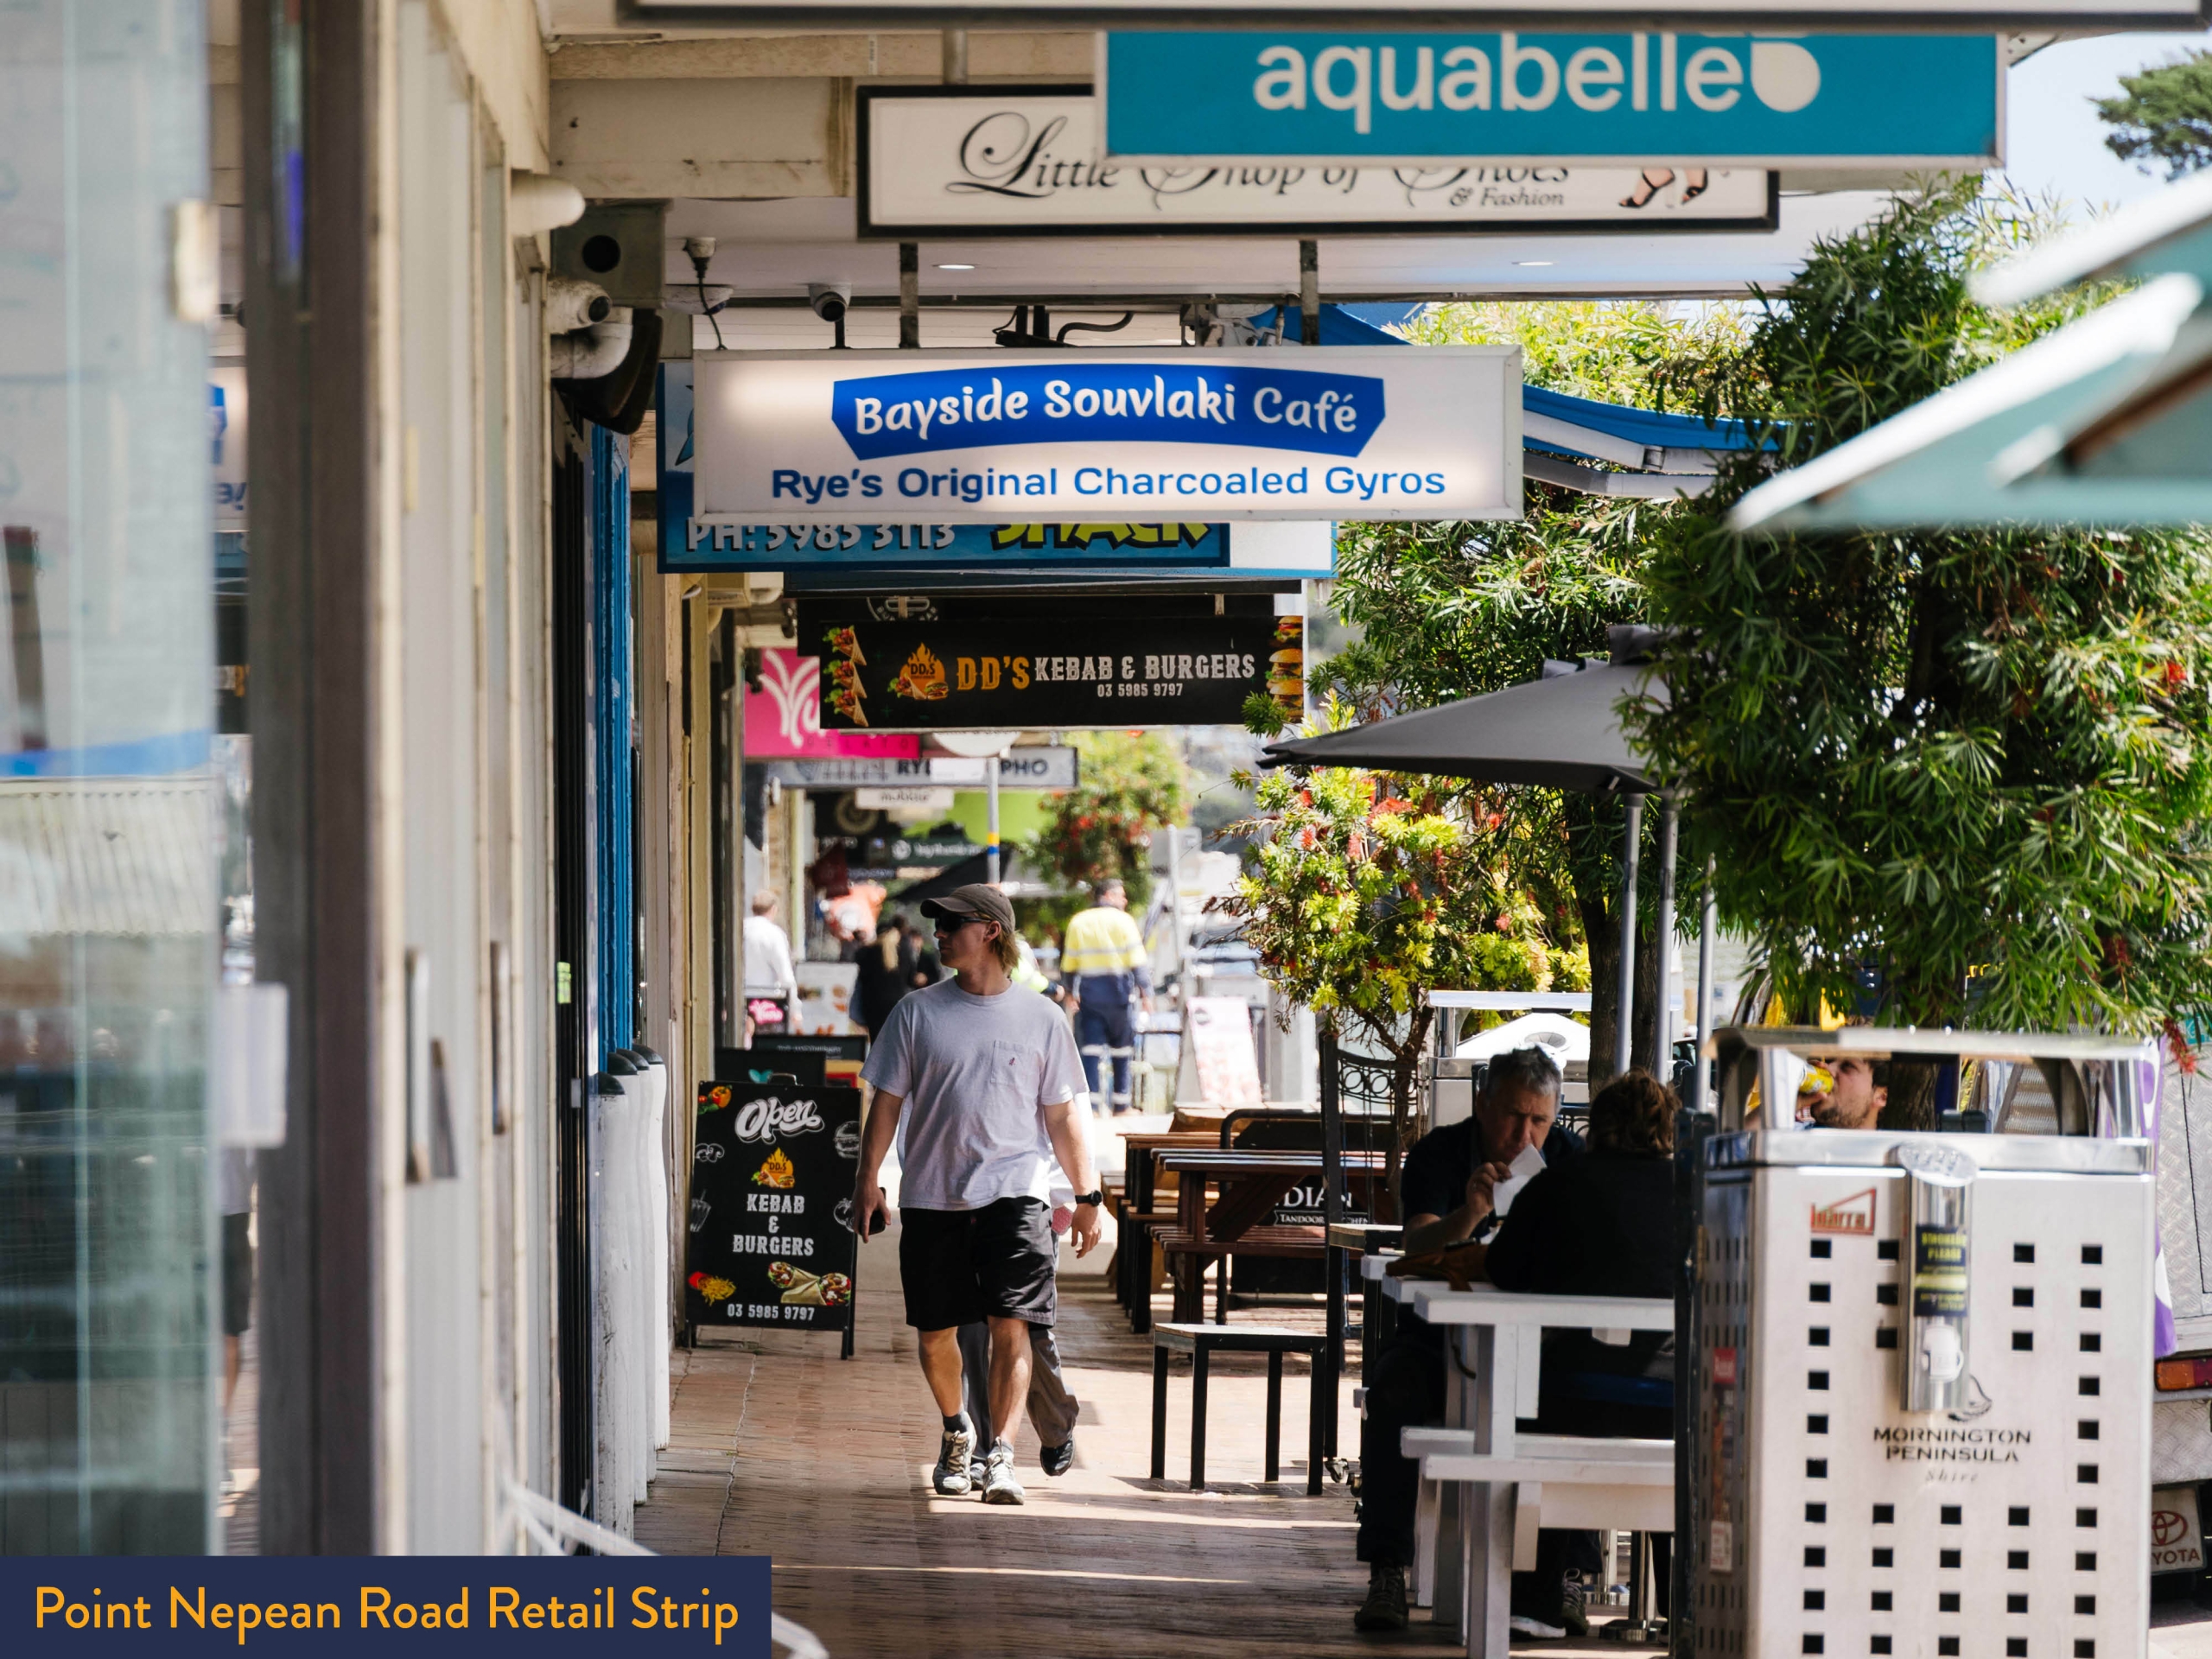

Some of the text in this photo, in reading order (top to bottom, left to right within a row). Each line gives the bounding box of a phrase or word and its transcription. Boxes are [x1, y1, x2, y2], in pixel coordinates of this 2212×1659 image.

[1253, 33, 1744, 135] aquabelle
[945, 112, 1120, 198] Little
[1449, 187, 1565, 207] & Fashion
[855, 374, 1357, 441] Bayside Souvlaki Café
[773, 467, 1446, 504] Rye's Original Charcoaled Gyros
[956, 653, 1255, 690] DD'S KEBAB & BURGERS
[1096, 683, 1184, 697] 03 5985 9797
[1000, 759, 1048, 776] PHO
[734, 1096, 826, 1145] Open
[747, 1193, 804, 1214] KEBAB
[768, 1216, 779, 1234] &
[733, 1234, 814, 1256] BURGERS
[727, 1303, 815, 1321] 03 5985 9797
[1873, 1427, 2031, 1444] MORNINGTON
[1886, 1446, 2019, 1462] PENINSULA
[2151, 1548, 2201, 1566] YOTA
